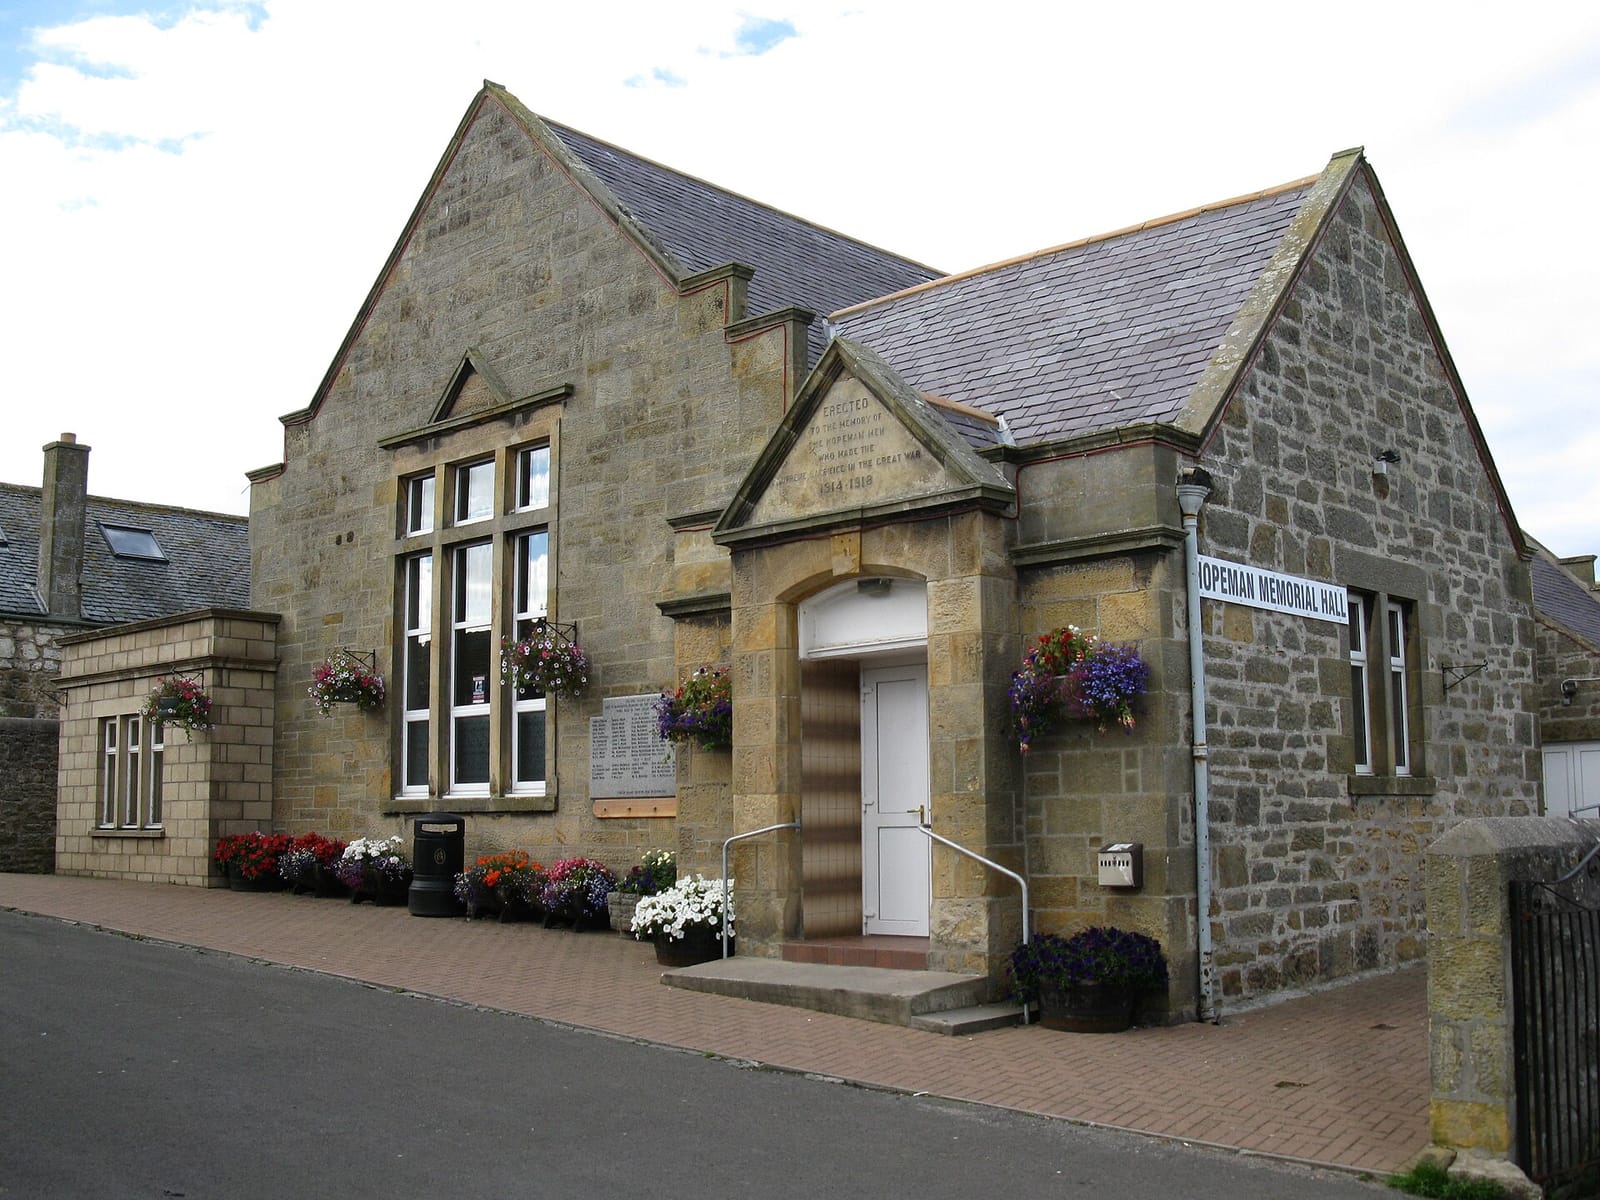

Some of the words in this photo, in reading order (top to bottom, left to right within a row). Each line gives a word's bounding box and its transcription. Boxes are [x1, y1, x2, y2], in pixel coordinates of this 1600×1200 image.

[823, 398, 869, 418] ERECTED
[809, 426, 820, 434] TO
[823, 422, 837, 433] THE
[839, 415, 871, 428] MEMORY
[873, 412, 882, 422] OF
[826, 431, 864, 447] HOPEMAN
[868, 426, 884, 438] MEN
[818, 452, 835, 462] WHO
[837, 447, 858, 459] MADE
[861, 444, 874, 454] THE
[848, 463, 856, 472] IN
[858, 459, 873, 469] THE
[876, 453, 901, 466] GREAT
[904, 450, 921, 461] WAR
[1258, 575, 1319, 613] MEMORIAL
[1320, 588, 1347, 618] HALL
